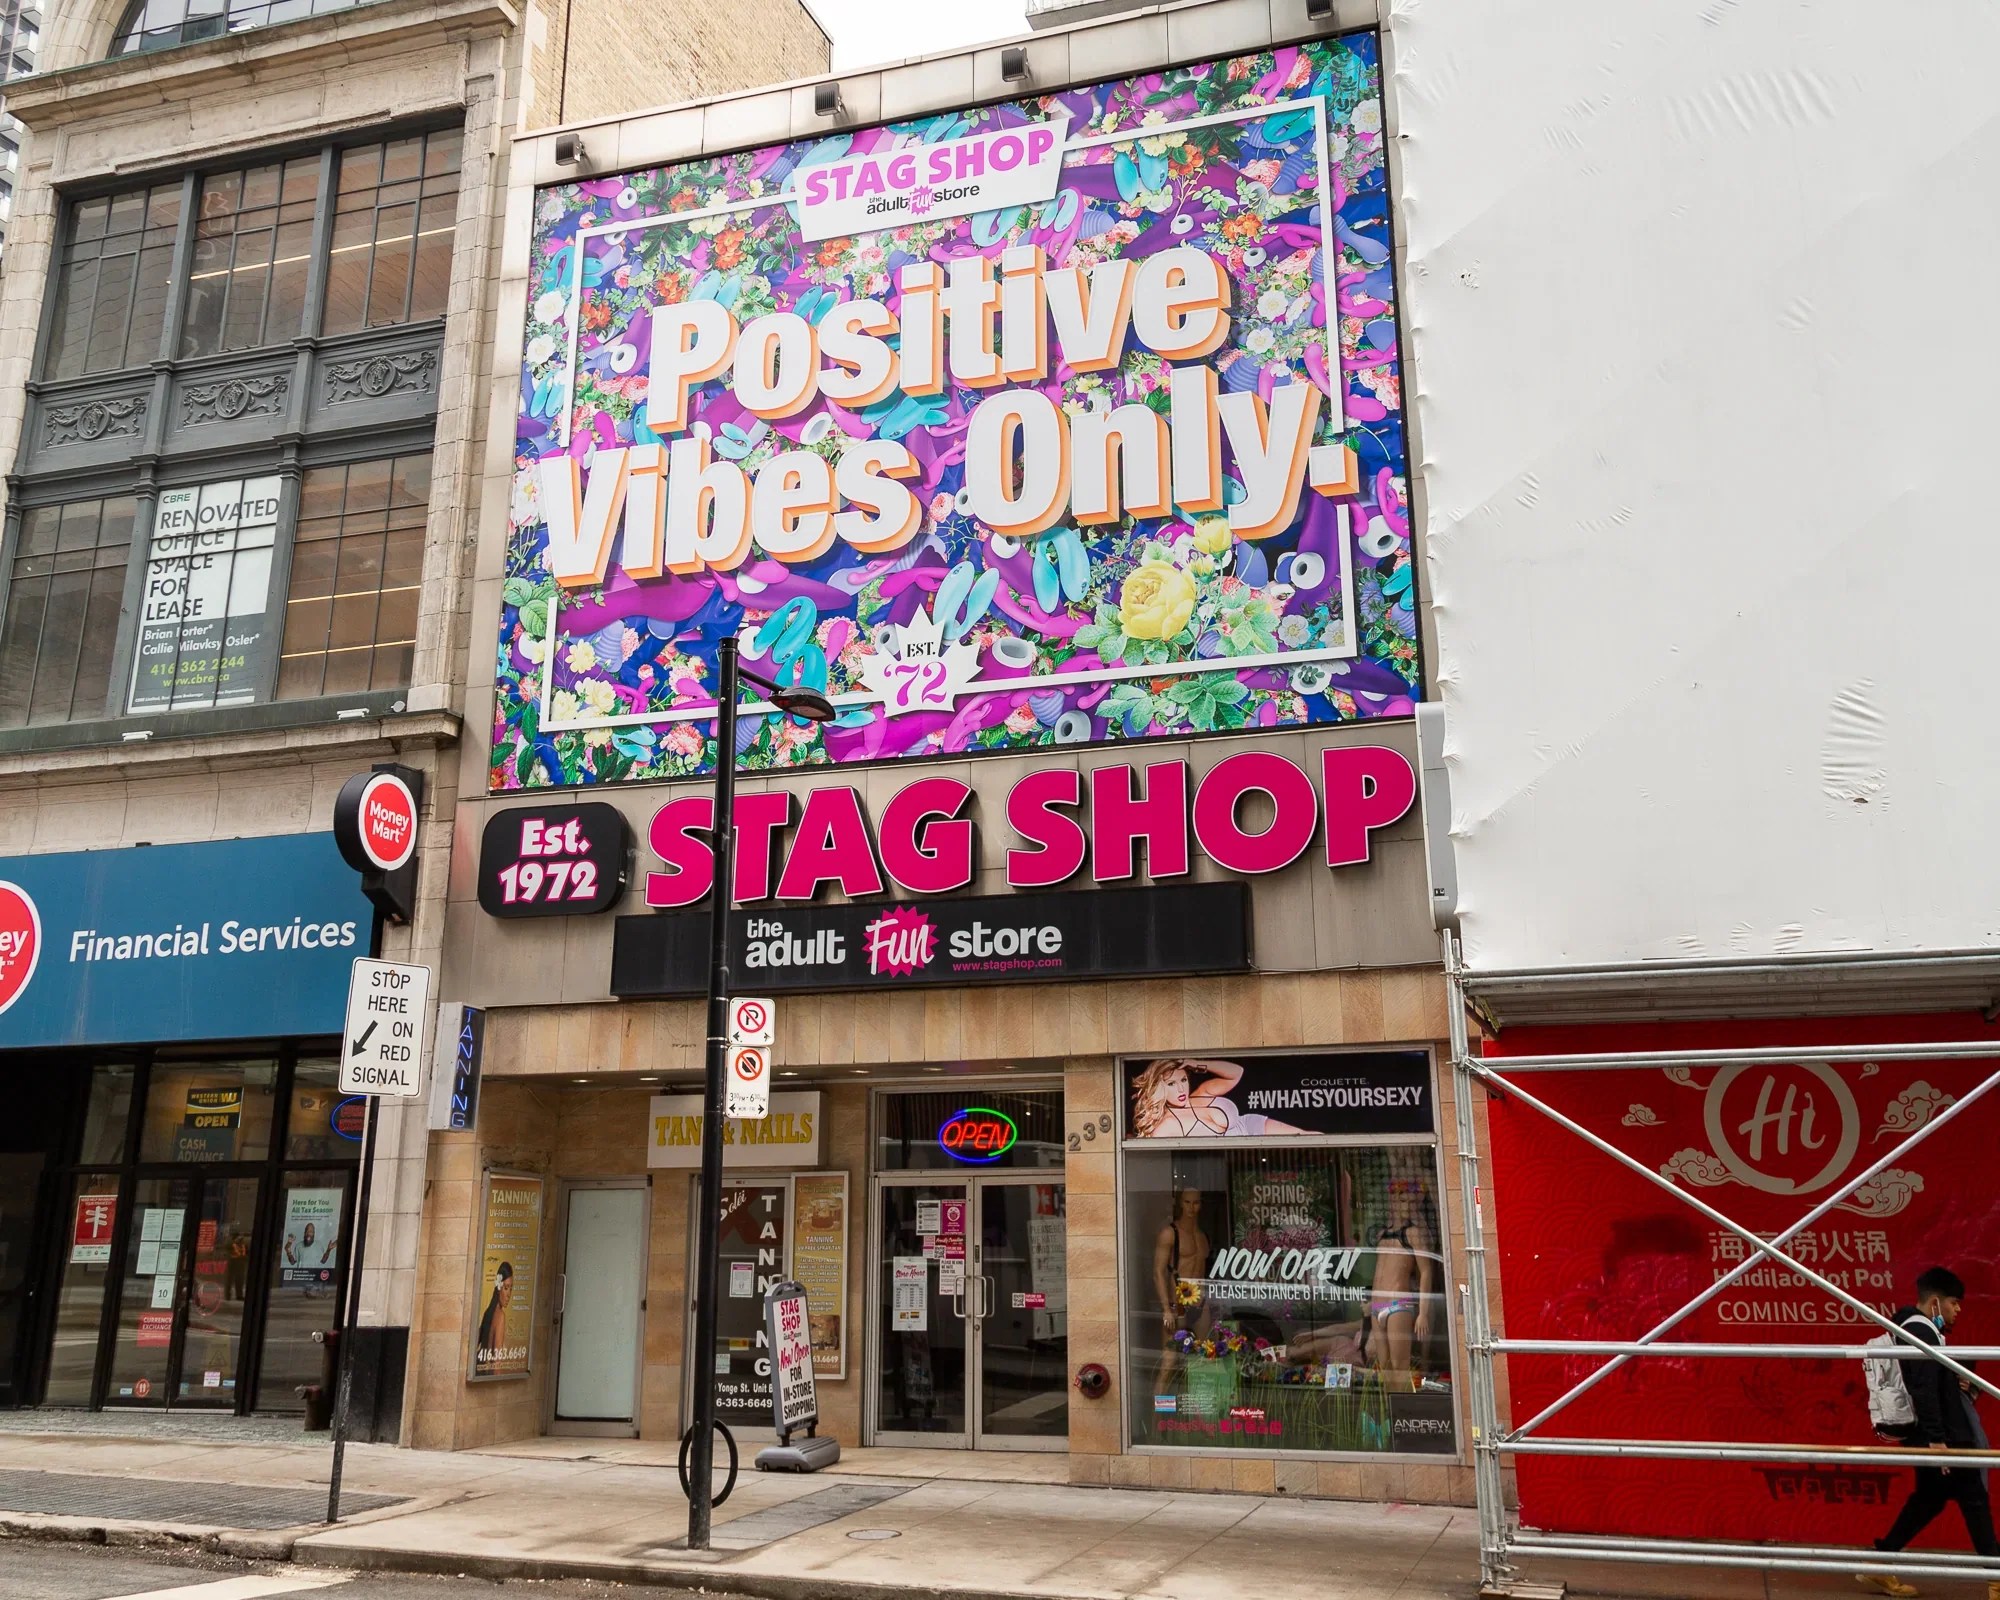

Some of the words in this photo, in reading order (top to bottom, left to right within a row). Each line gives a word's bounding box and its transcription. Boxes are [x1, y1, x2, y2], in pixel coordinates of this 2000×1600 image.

[805, 154, 916, 207] STAG
[929, 129, 1054, 185] SHOP
[866, 196, 909, 215] adult
[933, 185, 980, 203] store
[644, 244, 1231, 434] Positive
[540, 437, 922, 588] Vibes
[965, 365, 1359, 541] Only.
[162, 493, 191, 504] CBRE
[160, 498, 279, 529] RENOVATED
[157, 527, 226, 552] OFFICE
[152, 554, 213, 575] SPACE
[149, 577, 189, 598] FOR
[146, 598, 203, 620] LEASE
[144, 628, 173, 641] Brian
[176, 623, 214, 638] orter
[142, 643, 174, 655] Callie
[906, 641, 936, 658] EST.
[150, 663, 175, 676] 416
[181, 660, 205, 673] 362
[211, 655, 245, 670] 2244
[369, 800, 410, 832] Money
[372, 819, 401, 844] Mart
[520, 818, 591, 857] Est.
[645, 776, 977, 909] STAG
[1005, 745, 1417, 888] SHOP
[500, 859, 599, 906] 1972
[69, 922, 210, 962] Financial
[219, 916, 356, 954] Services
[746, 918, 784, 939] the
[745, 930, 846, 968] adult
[865, 917, 935, 976] Fun
[949, 921, 1063, 958] store
[952, 957, 1063, 972] www.stagshop.com
[371, 971, 411, 990] STOP
[367, 995, 409, 1014] HERE
[392, 1021, 414, 1038] ON
[379, 1044, 411, 1062] RED
[351, 1067, 410, 1086] SIGNAL
[451, 1008, 477, 1128] TANNING
[1300, 1078, 1367, 1087] COQUETTE
[1247, 1086, 1423, 1109] #WHATSYOURSEXY
[194, 1115, 229, 1128] OPEN
[740, 1113, 813, 1145] NAILS
[1738, 1075, 1827, 1162] Hi
[942, 1121, 1011, 1149] OPEN
[1067, 1114, 1112, 1152] 239
[179, 1138, 207, 1150] CASH
[177, 1150, 225, 1162] ADVANCE
[491, 1189, 537, 1205] TANNING
[1253, 1184, 1310, 1206] SPRING,
[1209, 1246, 1282, 1280] NOW
[1280, 1247, 1362, 1281] OPEN
[1854, 1268, 1893, 1289] Pot
[157, 1289, 169, 1298] 10
[1208, 1284, 1248, 1300] PLEASE
[1250, 1285, 1301, 1300] DISTANCE
[1303, 1287, 1311, 1300] 6
[1313, 1286, 1328, 1301] FT.
[1330, 1287, 1341, 1300] IN
[1343, 1286, 1367, 1301] LINE
[780, 1299, 800, 1317] STAG
[1717, 1301, 1818, 1323] COMING
[1824, 1301, 1896, 1323] SOON
[143, 1316, 173, 1324] CURRENCY
[782, 1315, 801, 1332] SHOP
[477, 1346, 527, 1362] 416.363.6649
[789, 1366, 803, 1382] FOR
[717, 1382, 738, 1395] Yonge
[740, 1382, 750, 1393] St.
[753, 1382, 768, 1394] Unit
[783, 1381, 812, 1401] IN-STORE
[715, 1397, 773, 1408] 6-363-6649
[783, 1398, 815, 1420] SHOPPING
[1394, 1419, 1451, 1429] ANDREW
